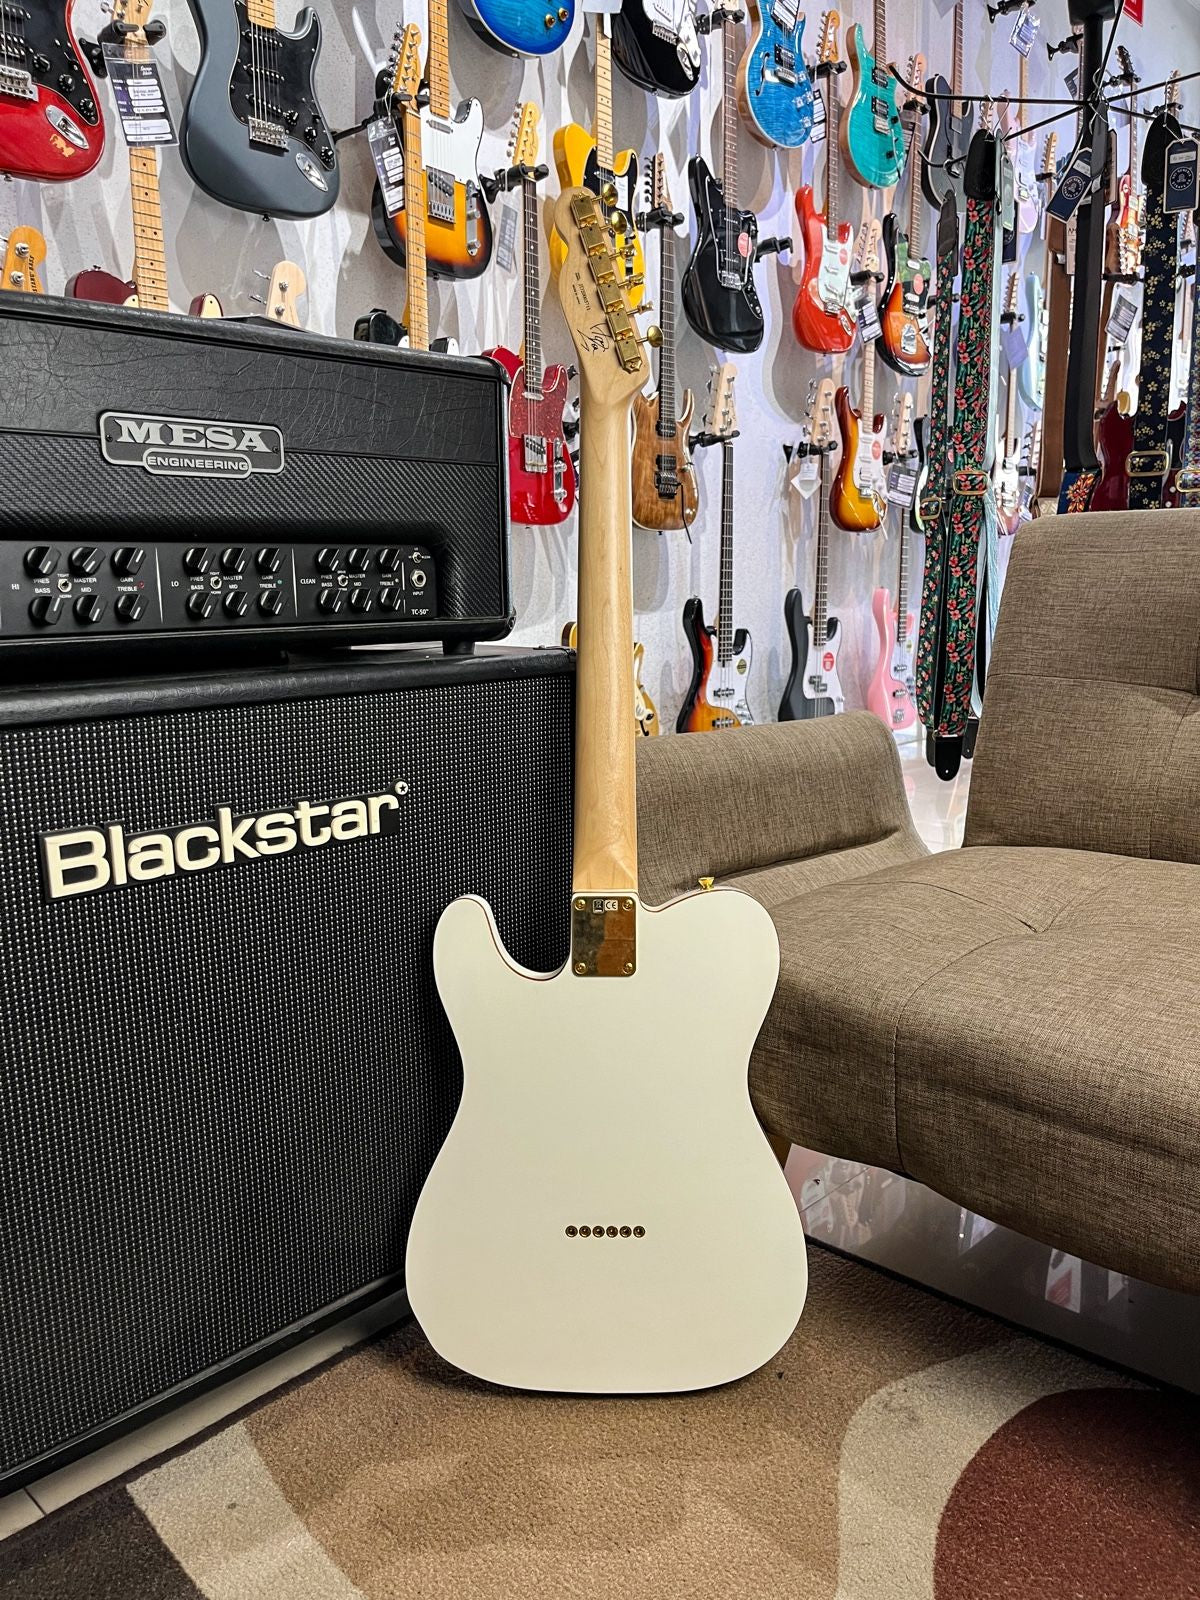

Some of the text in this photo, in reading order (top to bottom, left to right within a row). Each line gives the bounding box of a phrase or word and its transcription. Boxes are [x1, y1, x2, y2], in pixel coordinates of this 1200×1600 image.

[113, 418, 273, 453] MESA
[147, 456, 250, 471] ENGINEERING
[43, 792, 400, 899] Blackstar
